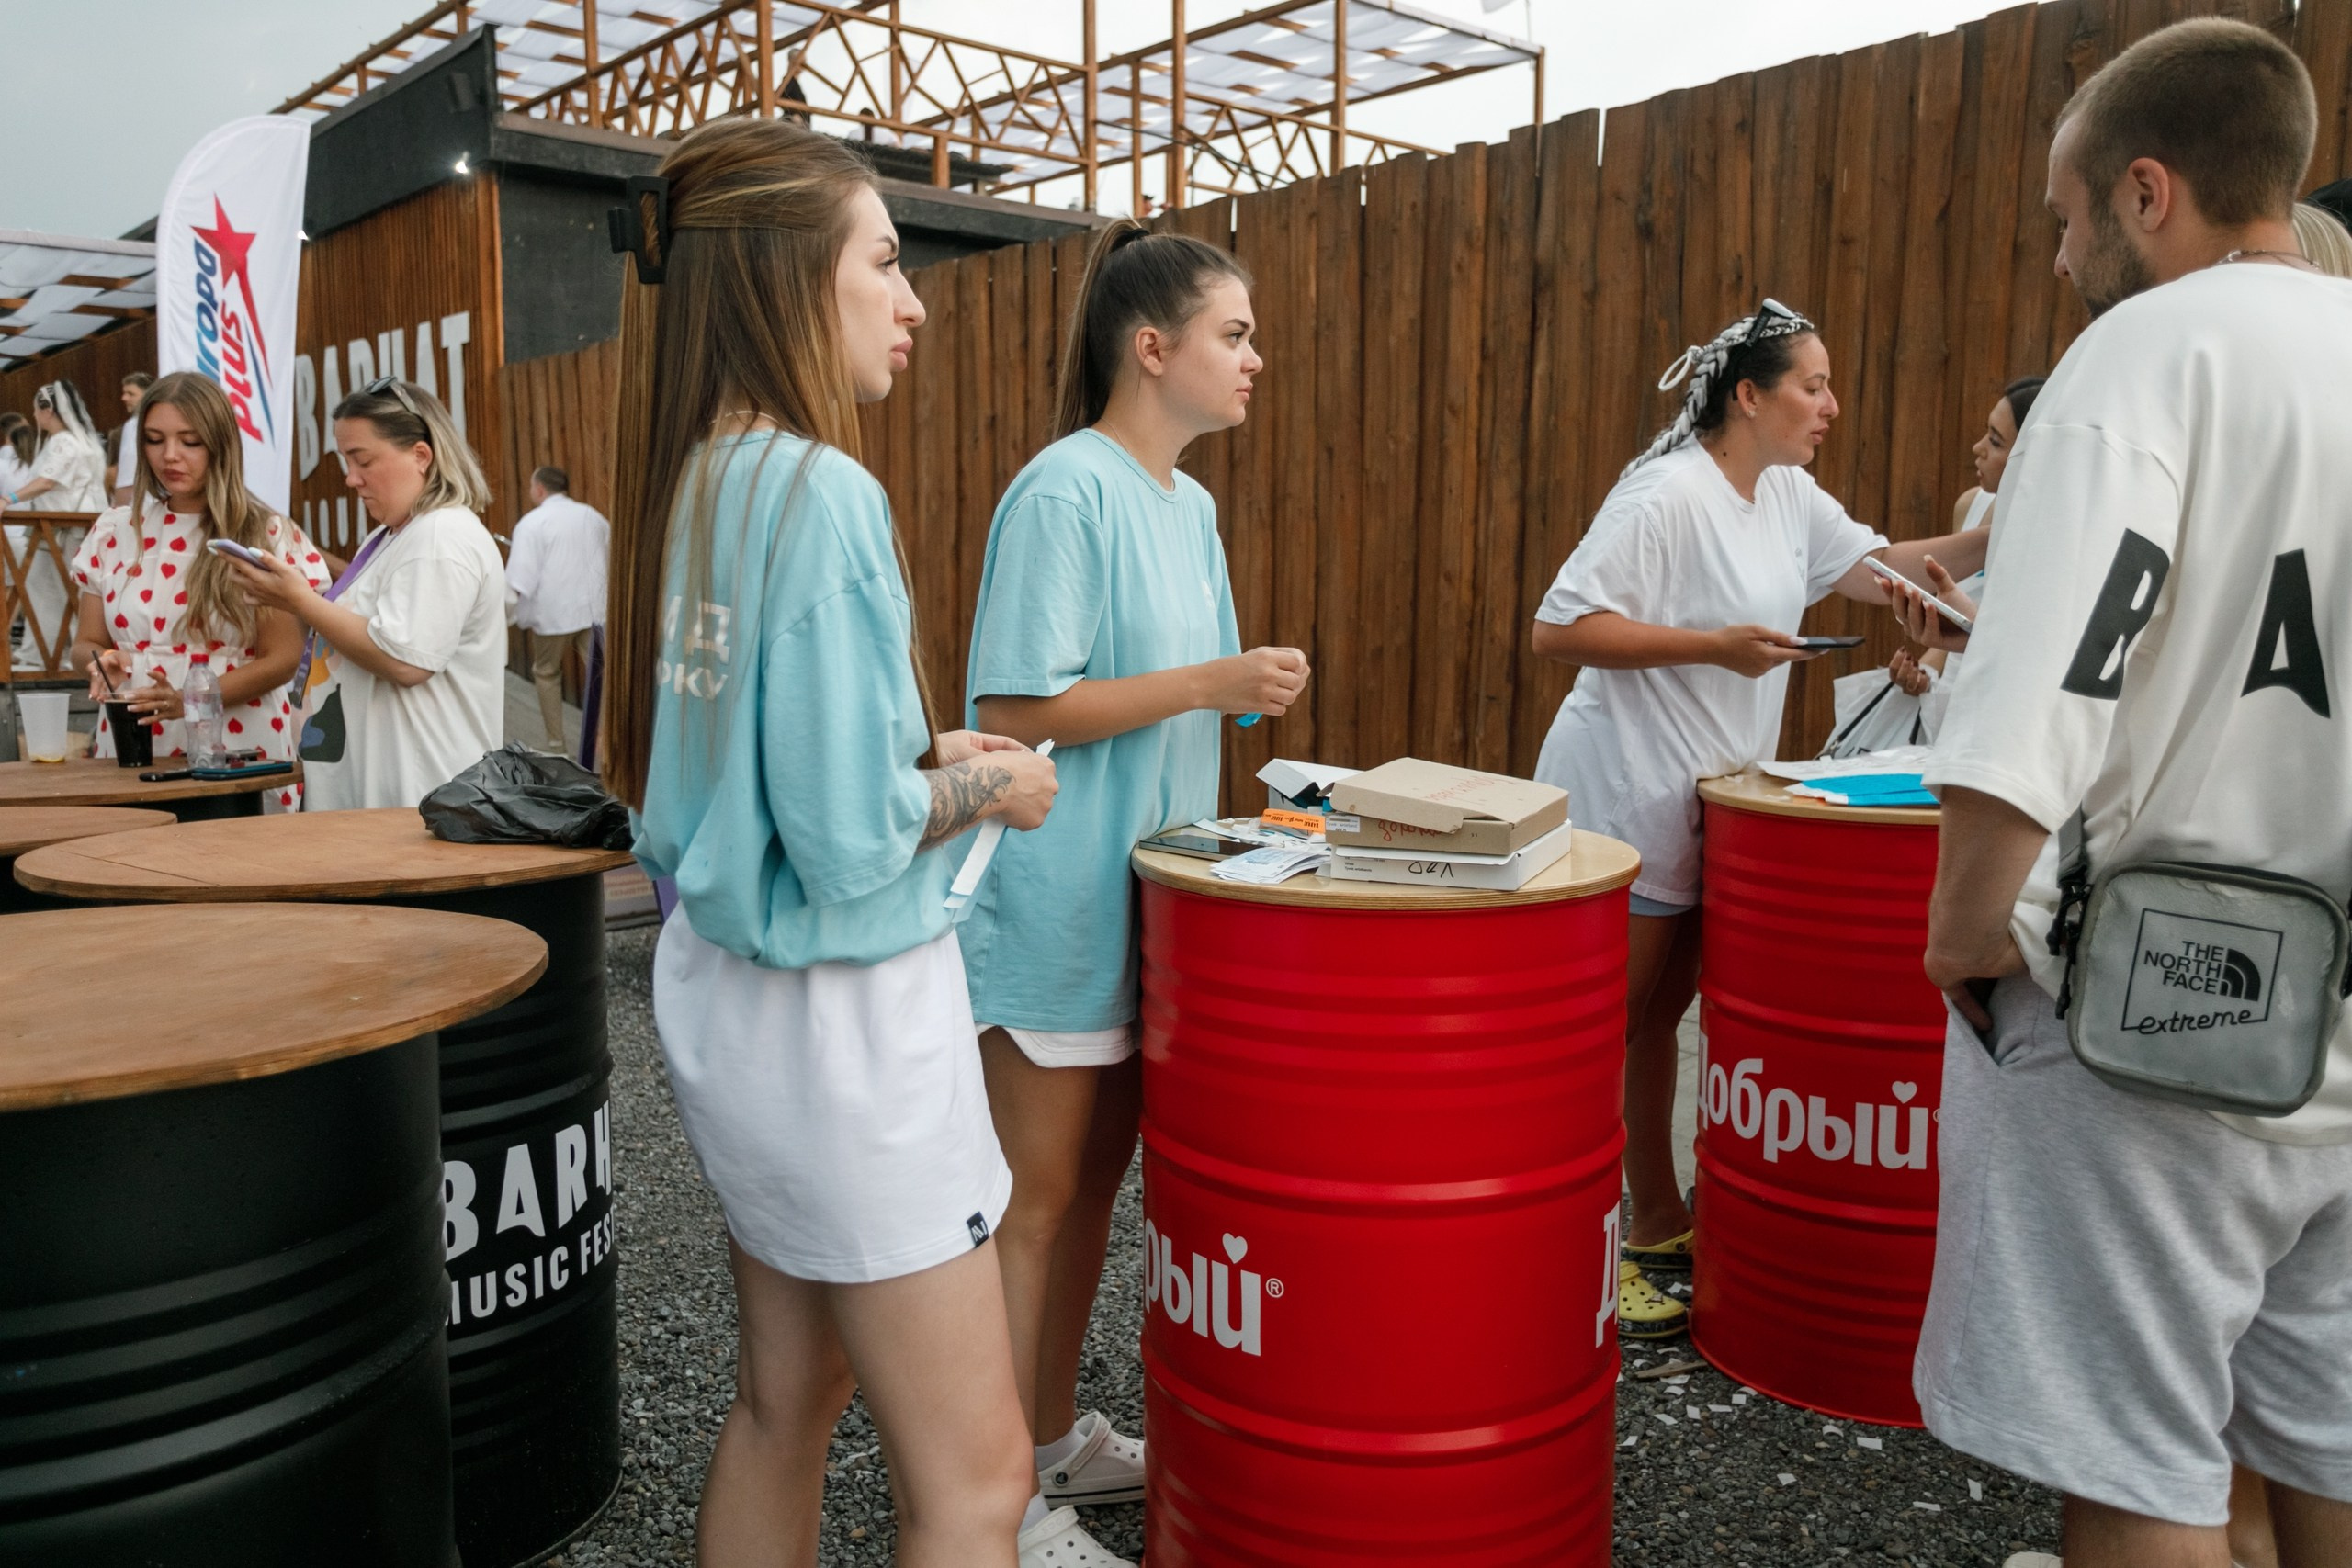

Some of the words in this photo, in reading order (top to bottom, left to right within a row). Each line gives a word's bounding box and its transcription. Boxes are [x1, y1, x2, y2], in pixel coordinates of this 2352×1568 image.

[220, 299, 264, 443] plus
[2143, 950, 2222, 979] NORTH
[2182, 940, 2224, 963] THE
[2162, 970, 2219, 995] FACE
[2138, 1010, 2252, 1035] extreme
[1699, 1029, 1928, 1170] Добрый
